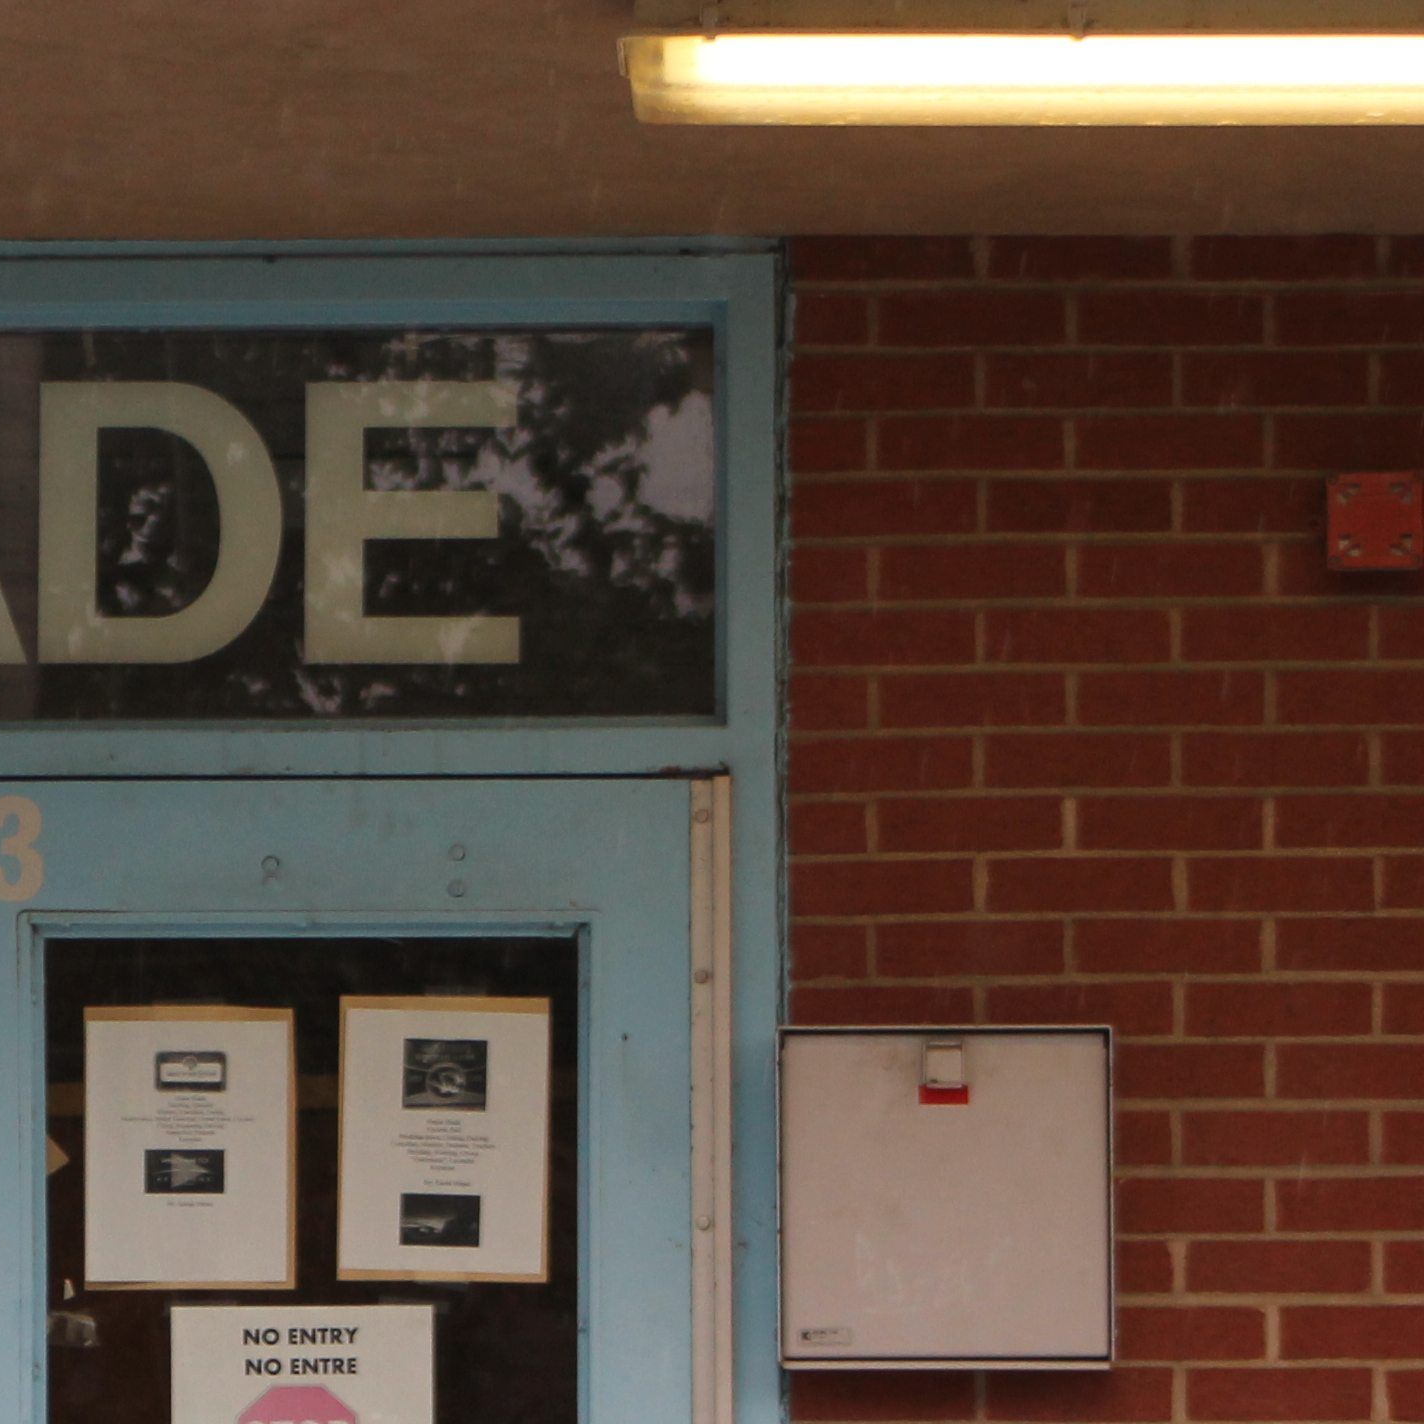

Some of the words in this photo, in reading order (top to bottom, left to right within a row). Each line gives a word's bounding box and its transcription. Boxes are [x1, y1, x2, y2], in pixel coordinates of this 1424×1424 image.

[243, 1328, 279, 1346] NO
[288, 1327, 358, 1345] ENTRY
[245, 1358, 281, 1376] NO
[290, 1357, 357, 1375] ENTRE
